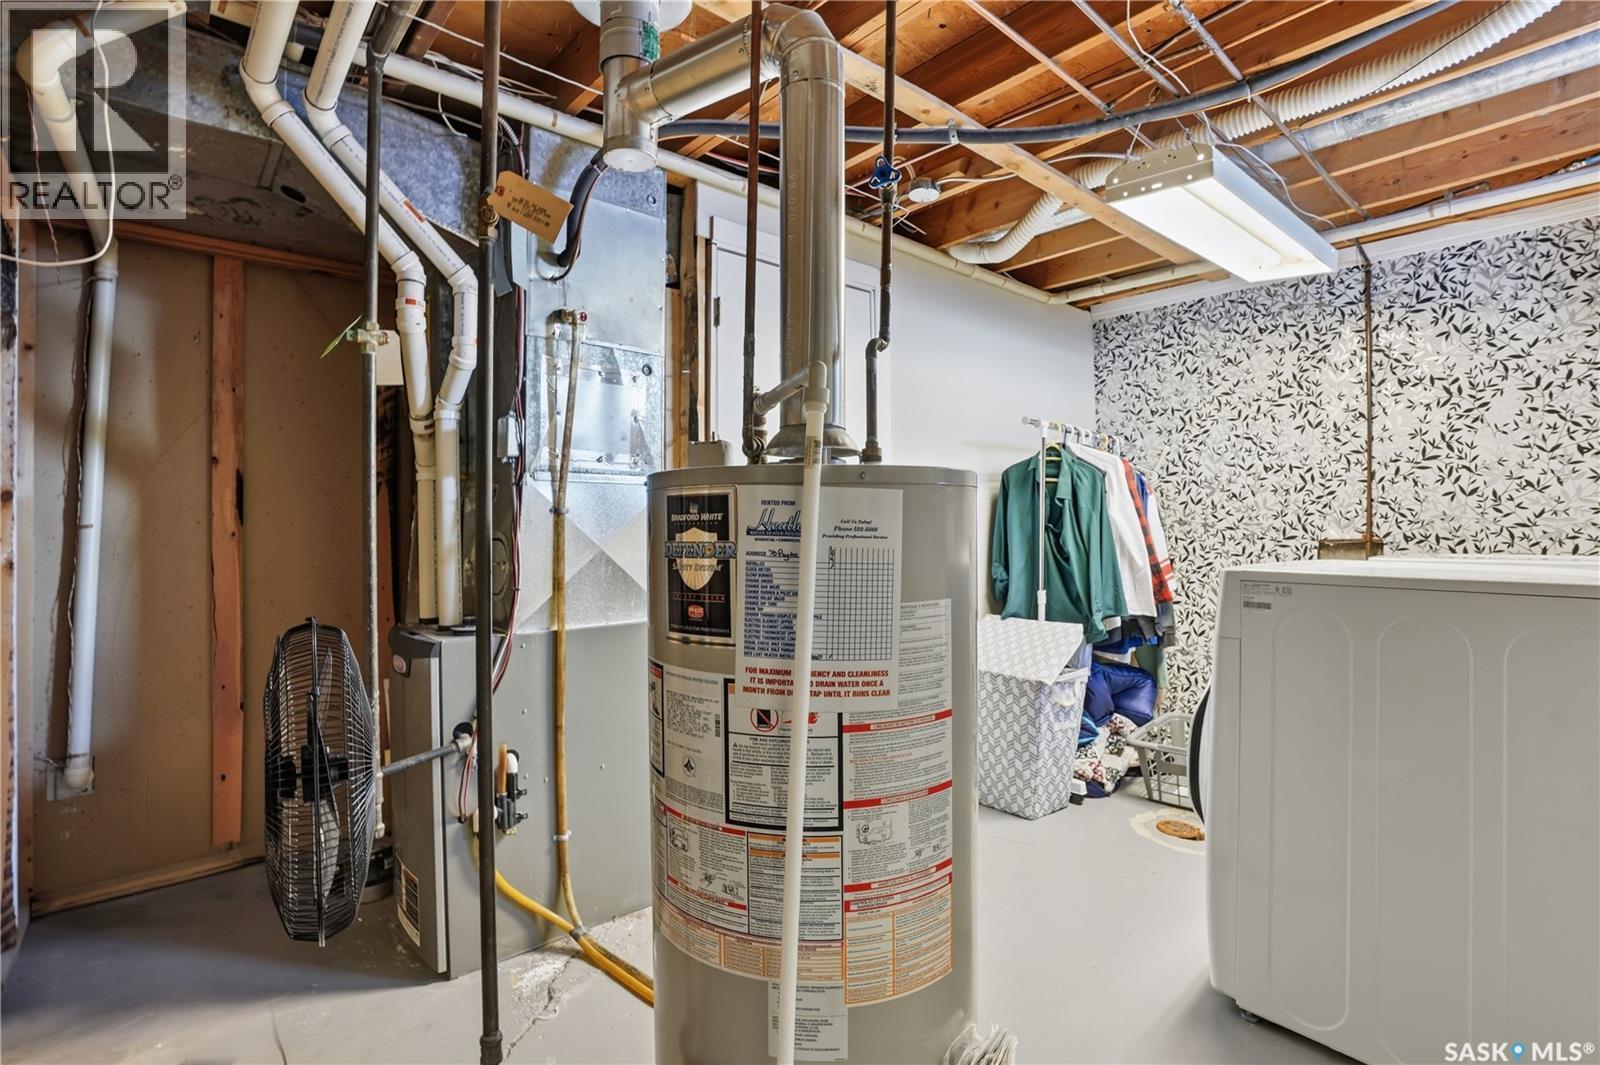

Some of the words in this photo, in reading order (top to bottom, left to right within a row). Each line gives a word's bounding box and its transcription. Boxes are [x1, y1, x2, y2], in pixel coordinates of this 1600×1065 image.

[671, 513, 700, 522] BRADFORD
[700, 512, 724, 521] WHITE
[665, 541, 736, 559] DEFENDER
[759, 668, 792, 676] MAXIMUM
[742, 686, 766, 694] MONTH
